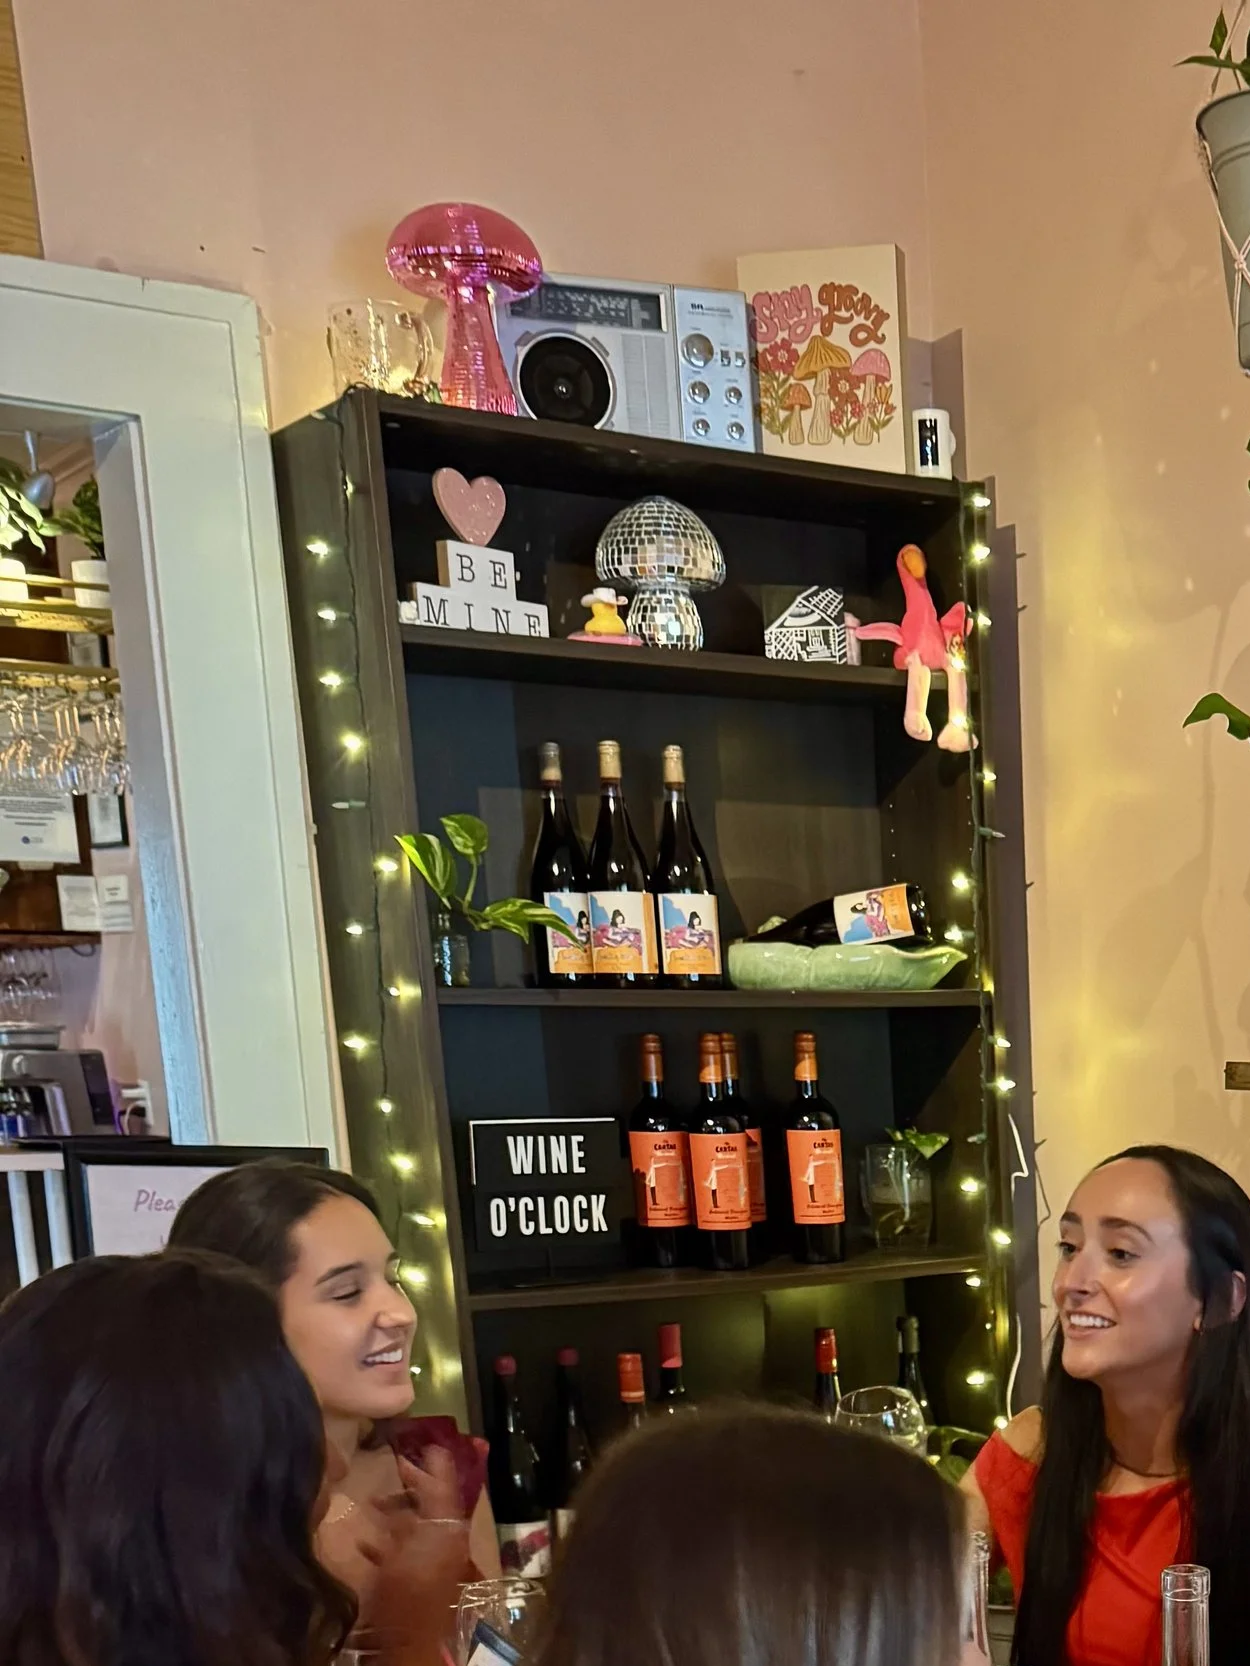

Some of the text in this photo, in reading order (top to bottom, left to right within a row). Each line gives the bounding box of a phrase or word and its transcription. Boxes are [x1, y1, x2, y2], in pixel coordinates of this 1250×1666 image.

[752, 282, 890, 347] Stay groovy
[456, 553, 508, 590] BE
[422, 594, 542, 637] MINE
[507, 1135, 586, 1175] WINE
[134, 1188, 182, 1213] Plea
[490, 1194, 609, 1238] O'CLOCK
